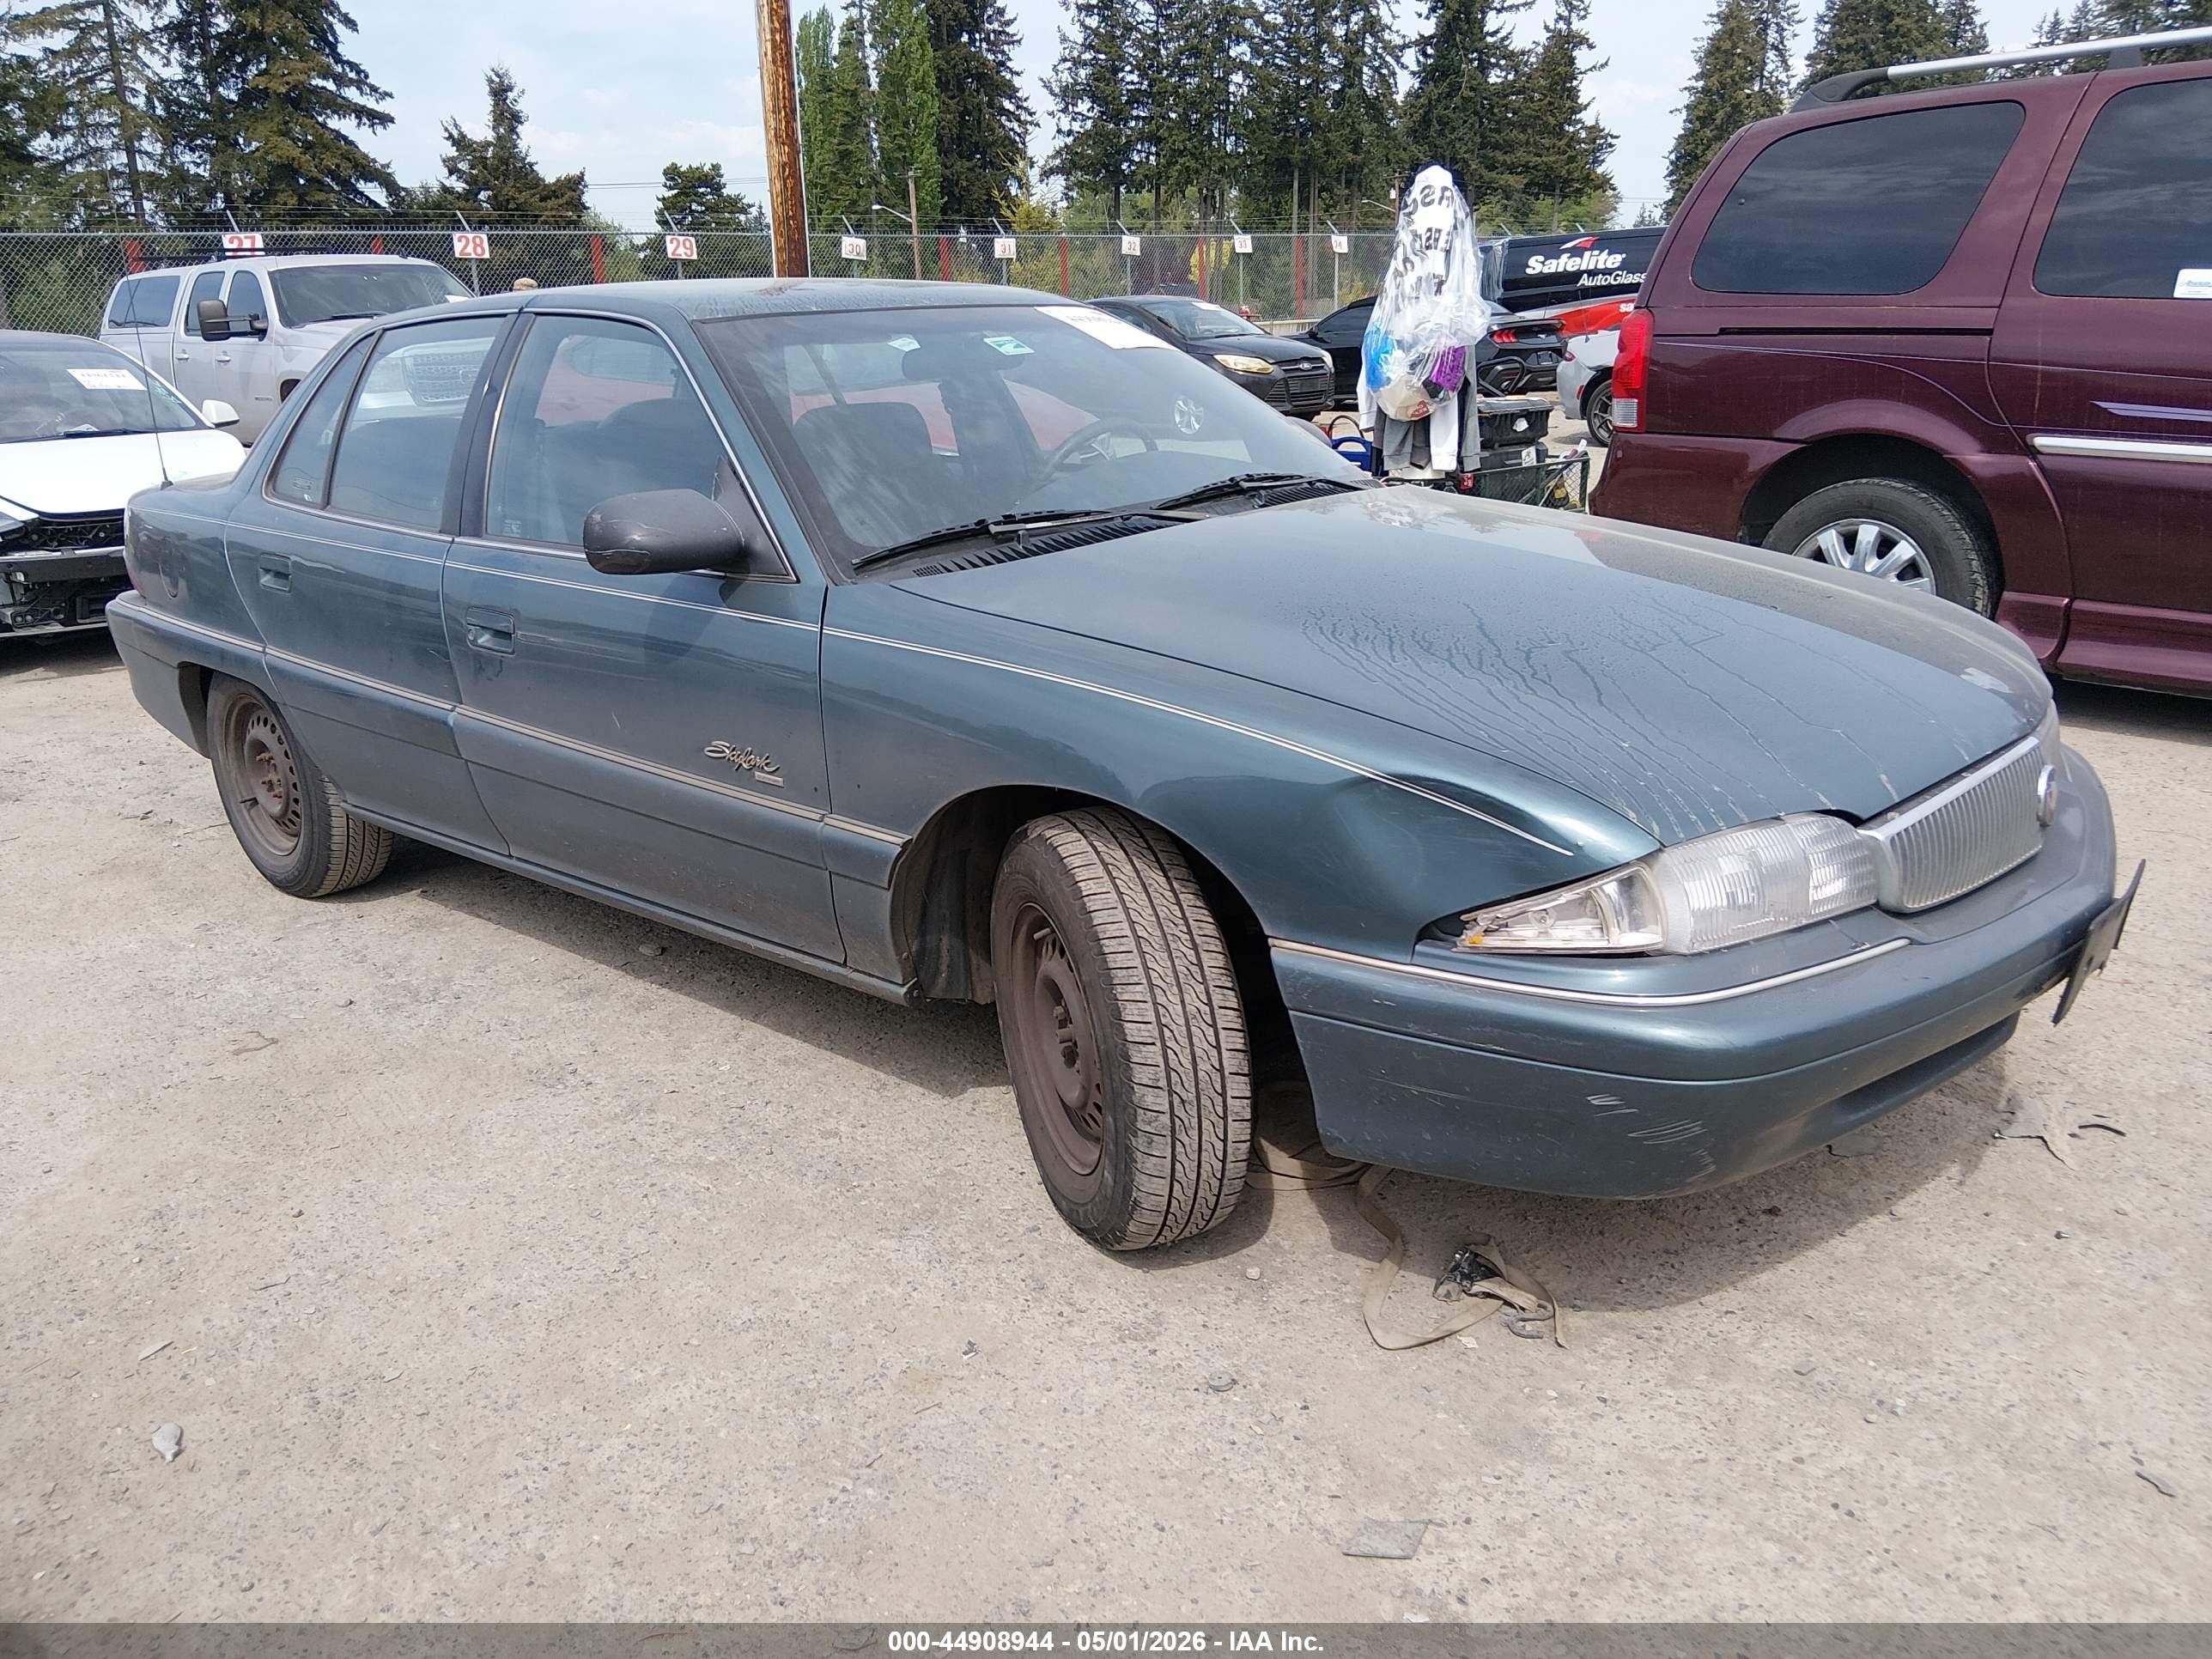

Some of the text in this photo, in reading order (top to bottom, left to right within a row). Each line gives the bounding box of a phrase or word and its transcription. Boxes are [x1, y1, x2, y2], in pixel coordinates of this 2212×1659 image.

[228, 234, 256, 257] 27
[457, 235, 486, 257] 28
[670, 237, 694, 258] 29
[848, 243, 861, 255] 30
[1000, 243, 1011, 254] 31
[1127, 241, 1137, 252] 32
[1525, 249, 1622, 275] Safelite
[704, 741, 780, 772] Skylark
